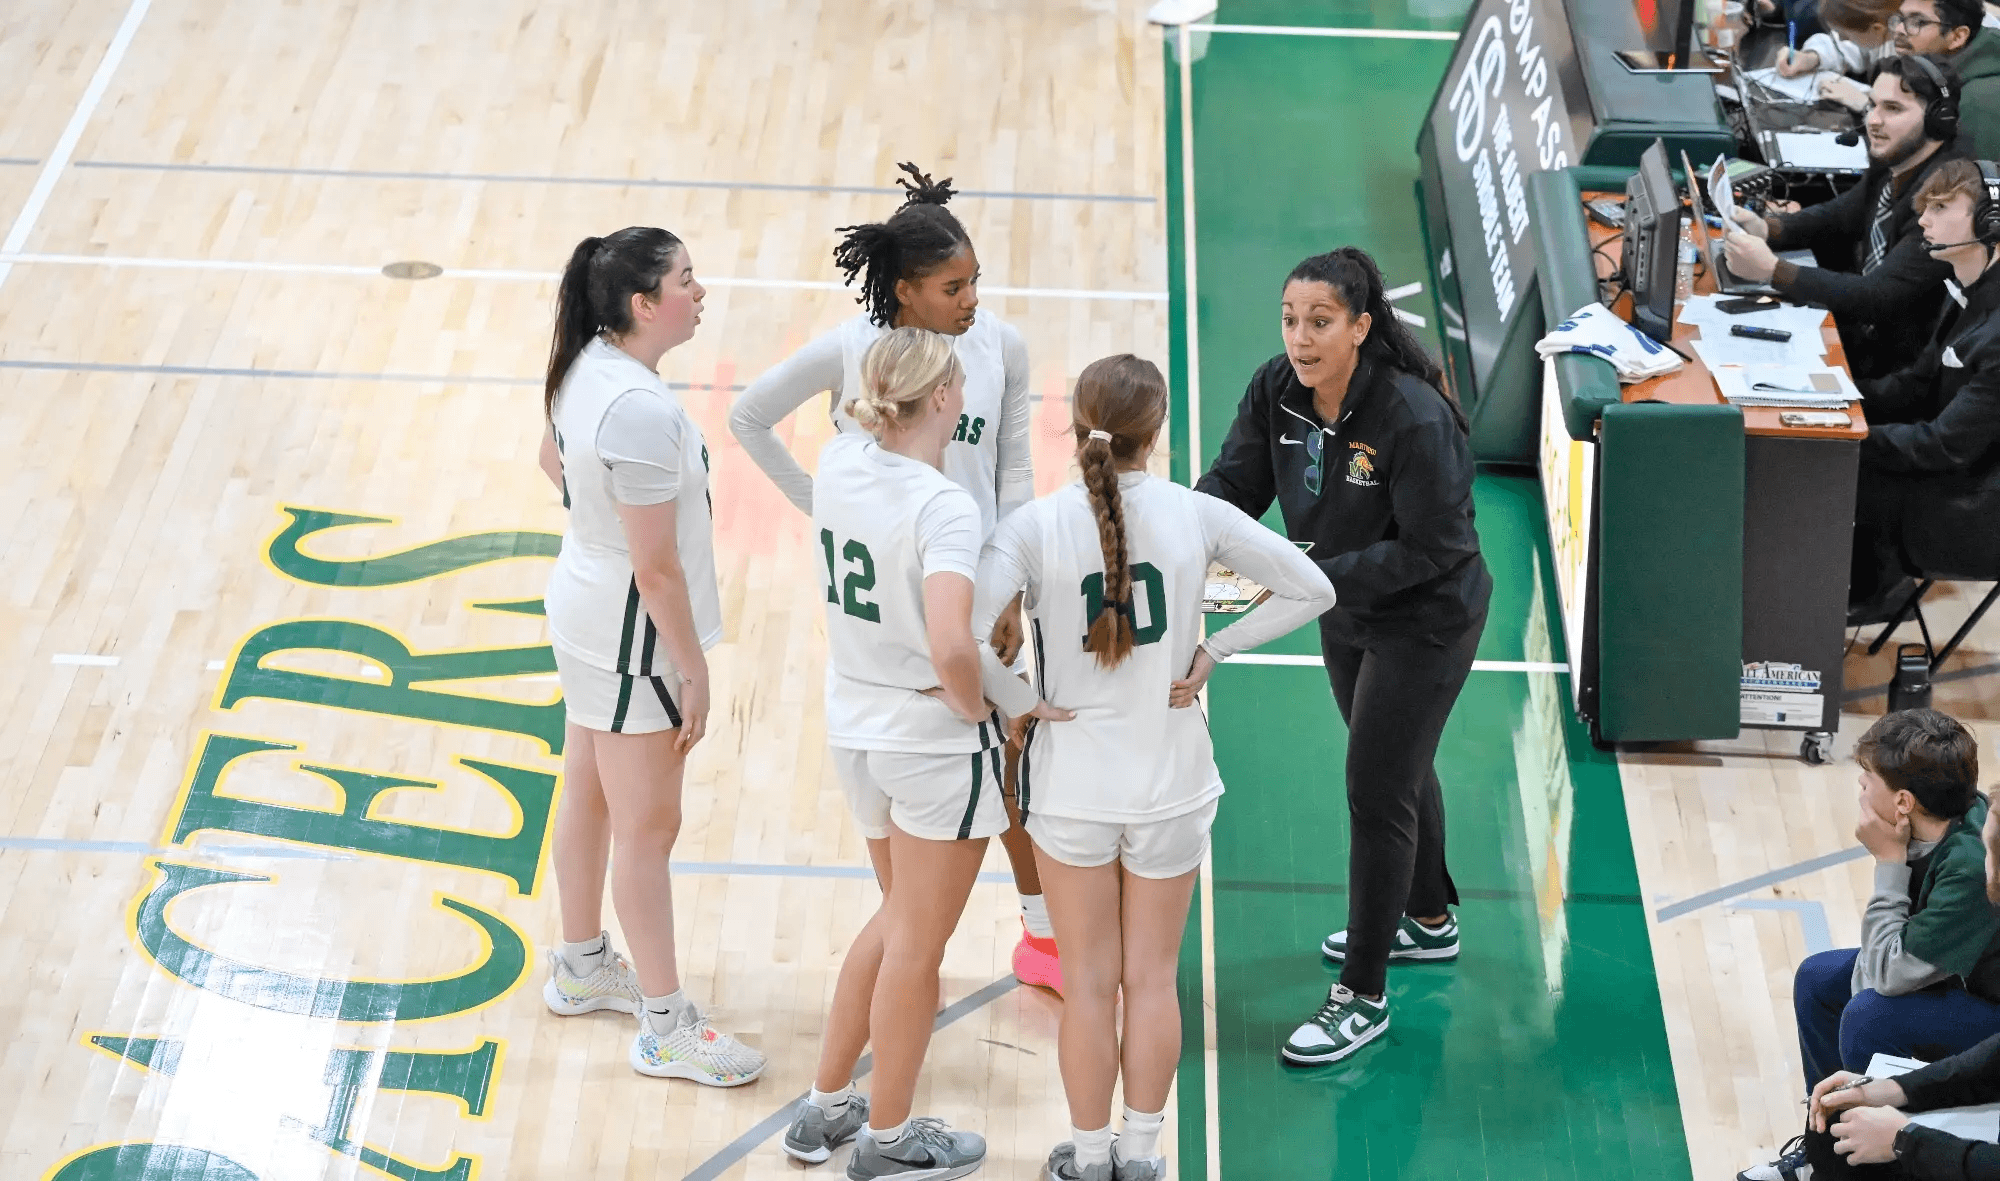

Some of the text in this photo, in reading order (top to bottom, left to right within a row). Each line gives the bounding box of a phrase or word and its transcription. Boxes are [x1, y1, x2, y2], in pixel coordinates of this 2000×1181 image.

[1504, 0, 1568, 170] OMPAS
[1490, 239, 1515, 322] TEAM
[820, 528, 881, 624] 12
[1081, 561, 1168, 652] 10
[40, 501, 567, 1181] ACERS
